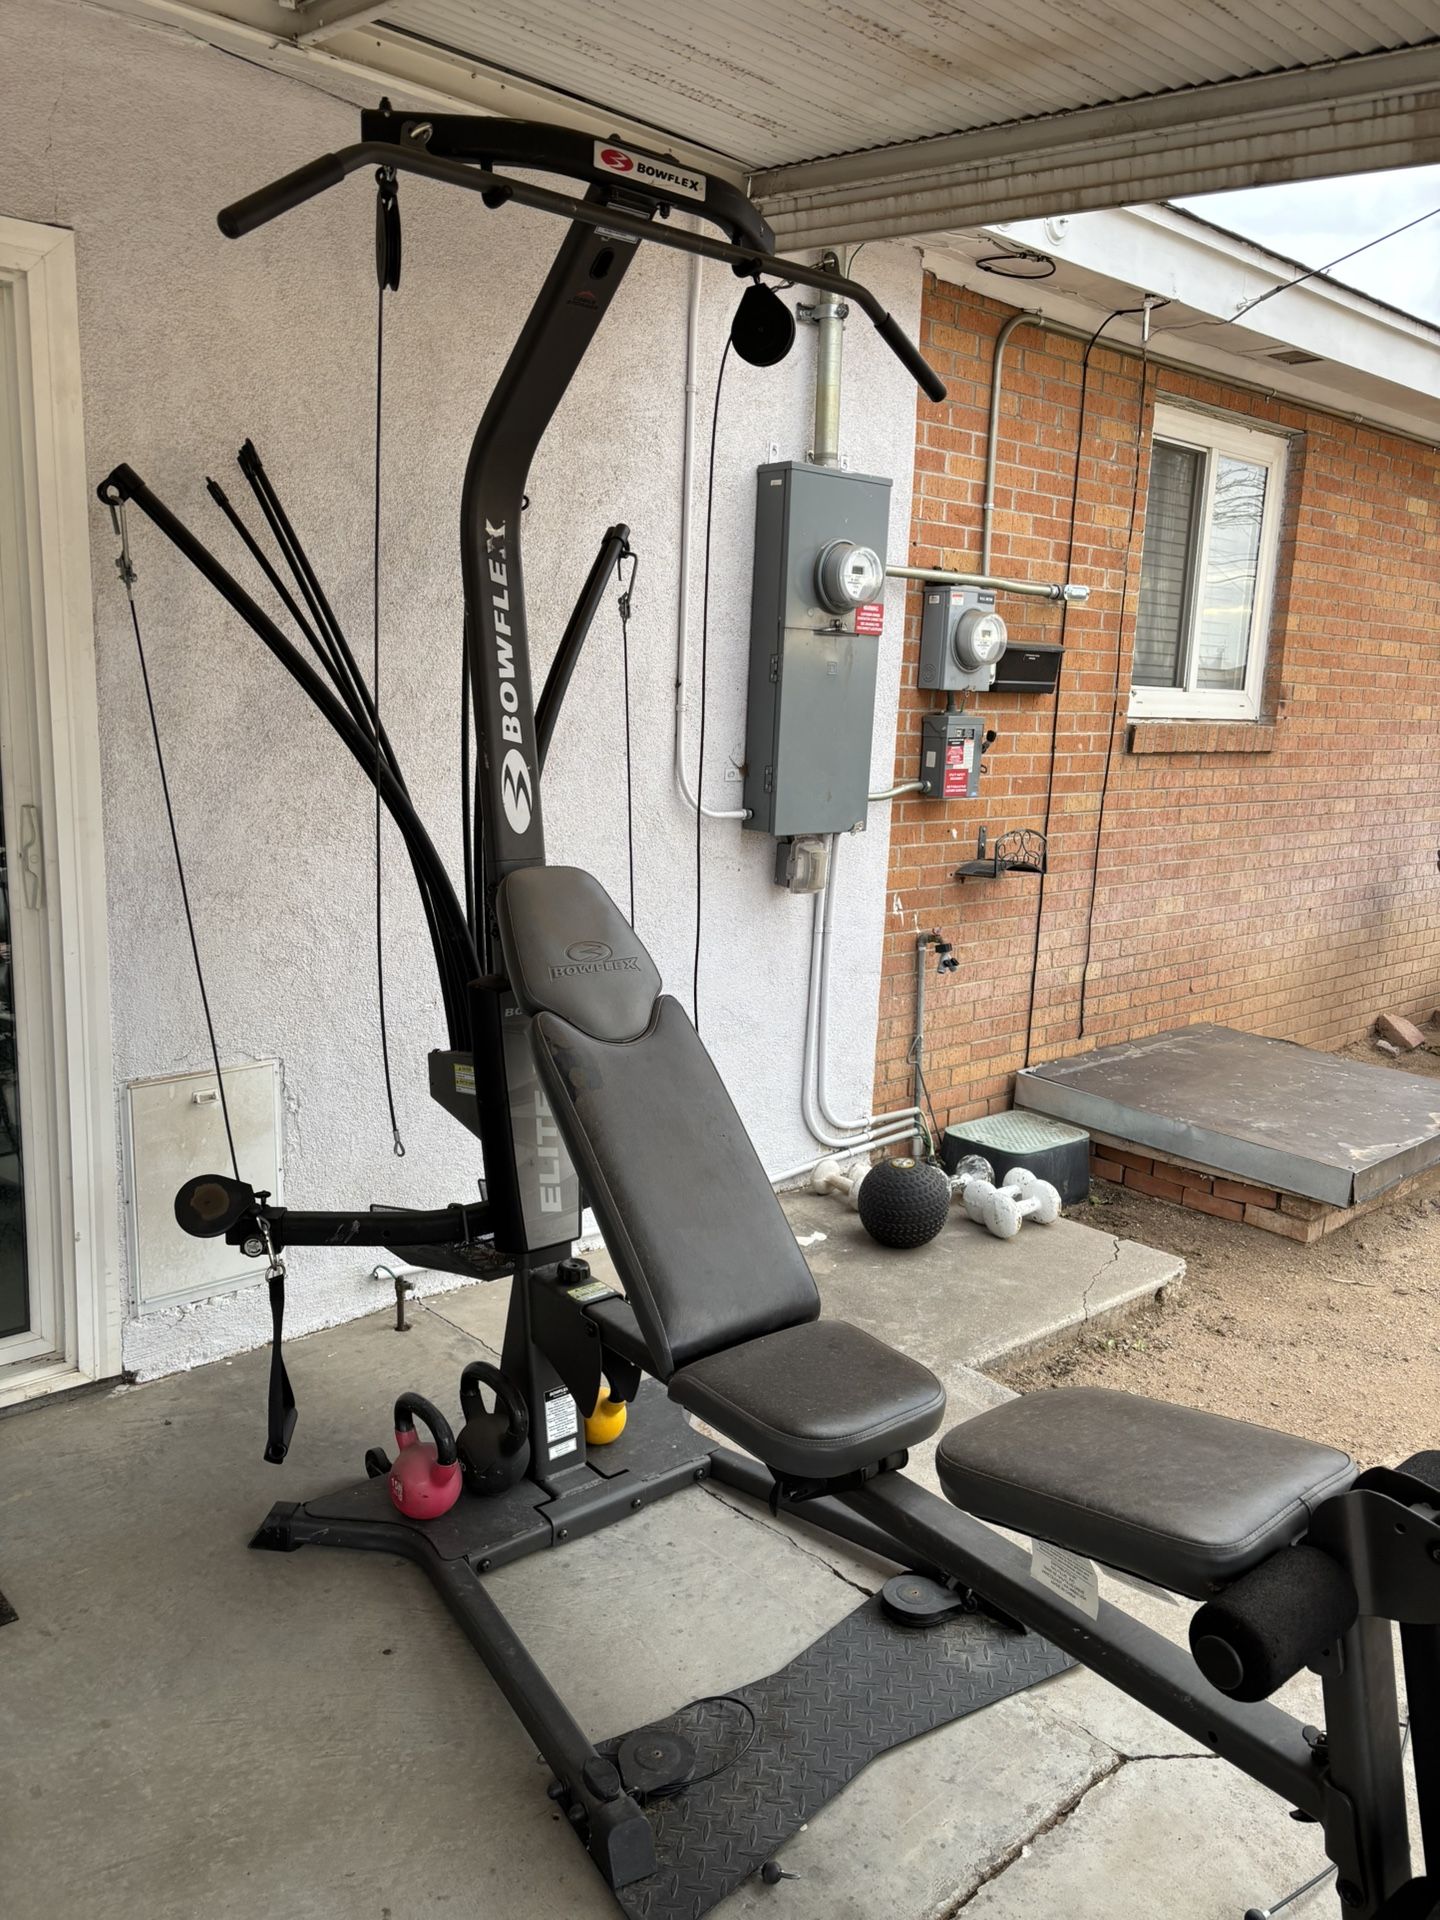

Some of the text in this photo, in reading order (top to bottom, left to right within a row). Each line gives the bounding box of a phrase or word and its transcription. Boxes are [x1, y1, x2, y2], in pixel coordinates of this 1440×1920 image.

[637, 162, 700, 192] BOWFLEX
[485, 518, 523, 744] BOWFLEX
[549, 957, 640, 982] BOWFLEX
